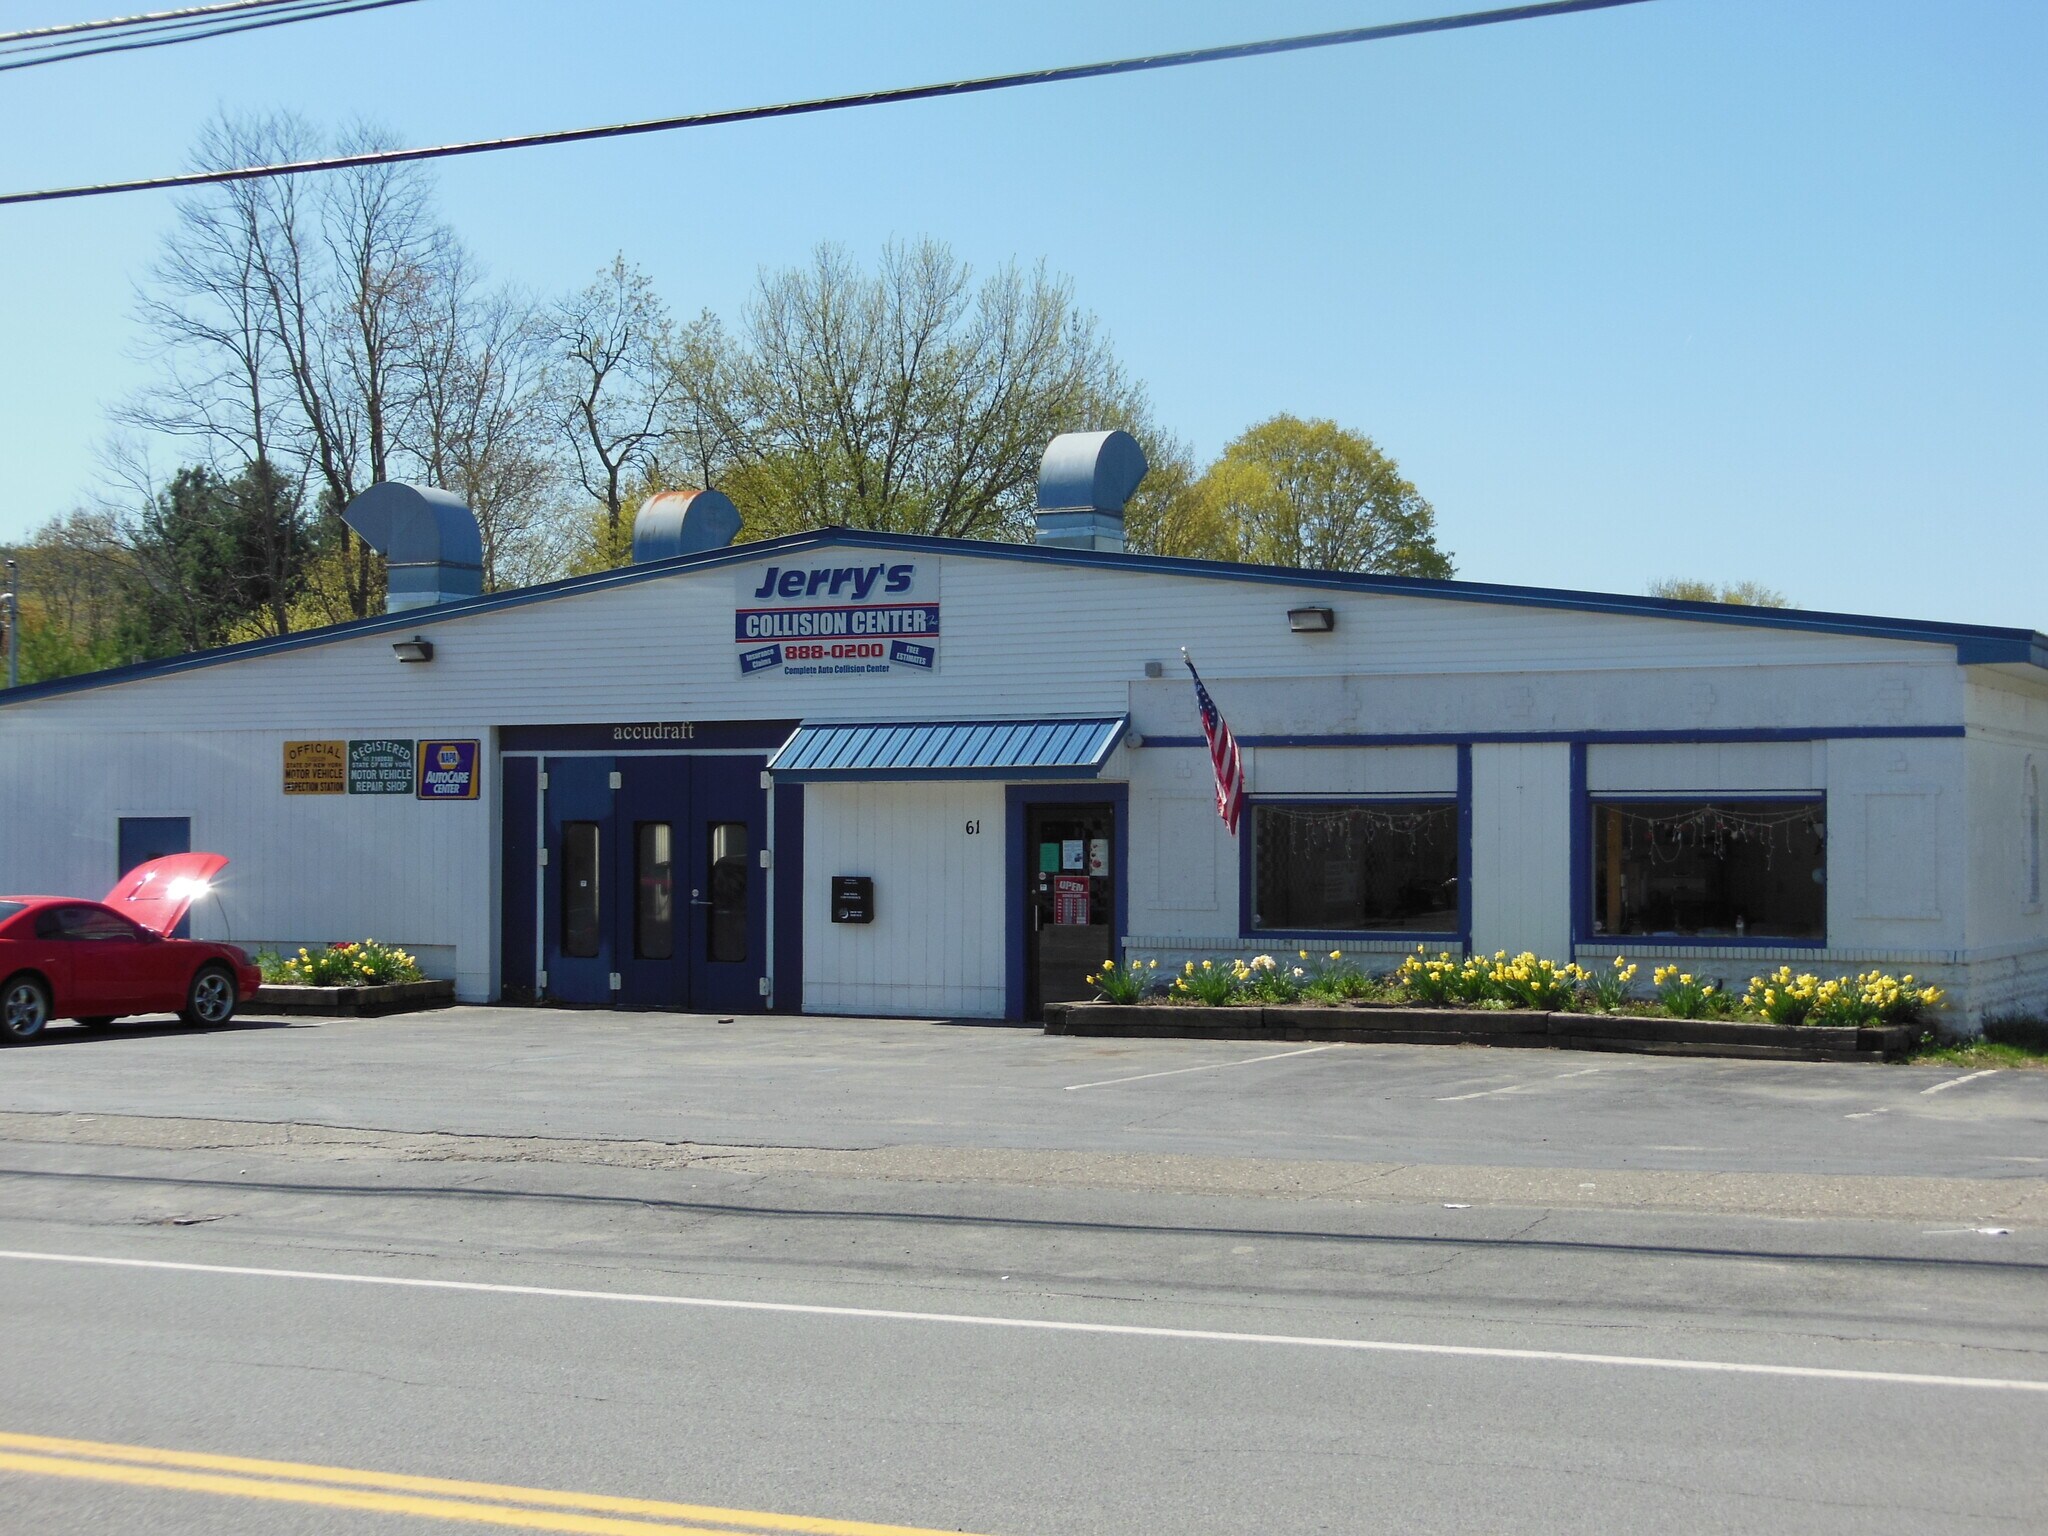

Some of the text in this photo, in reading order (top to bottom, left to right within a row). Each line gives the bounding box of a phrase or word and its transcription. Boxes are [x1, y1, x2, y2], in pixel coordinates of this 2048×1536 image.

[755, 563, 915, 600] Jerry's
[746, 612, 847, 638] COLLISION
[851, 609, 926, 634] CENTER
[784, 643, 884, 660] 888-0200
[906, 645, 920, 655] FREE
[896, 652, 927, 665] ESTIMATES
[784, 663, 890, 676] Complete Auto Collision Center
[613, 721, 695, 740] accudraft
[289, 743, 342, 760] OFFICIAL
[352, 741, 411, 761] REGISTERED
[286, 769, 344, 779] MOTOR VEHICLE
[351, 769, 412, 780] MOTOR VEHICLE
[320, 781, 344, 791] STATION
[356, 781, 408, 792] REPAIR SHOP
[433, 783, 460, 794] CENTER
[965, 820, 980, 835] 61
[1059, 880, 1084, 892] OPEN
